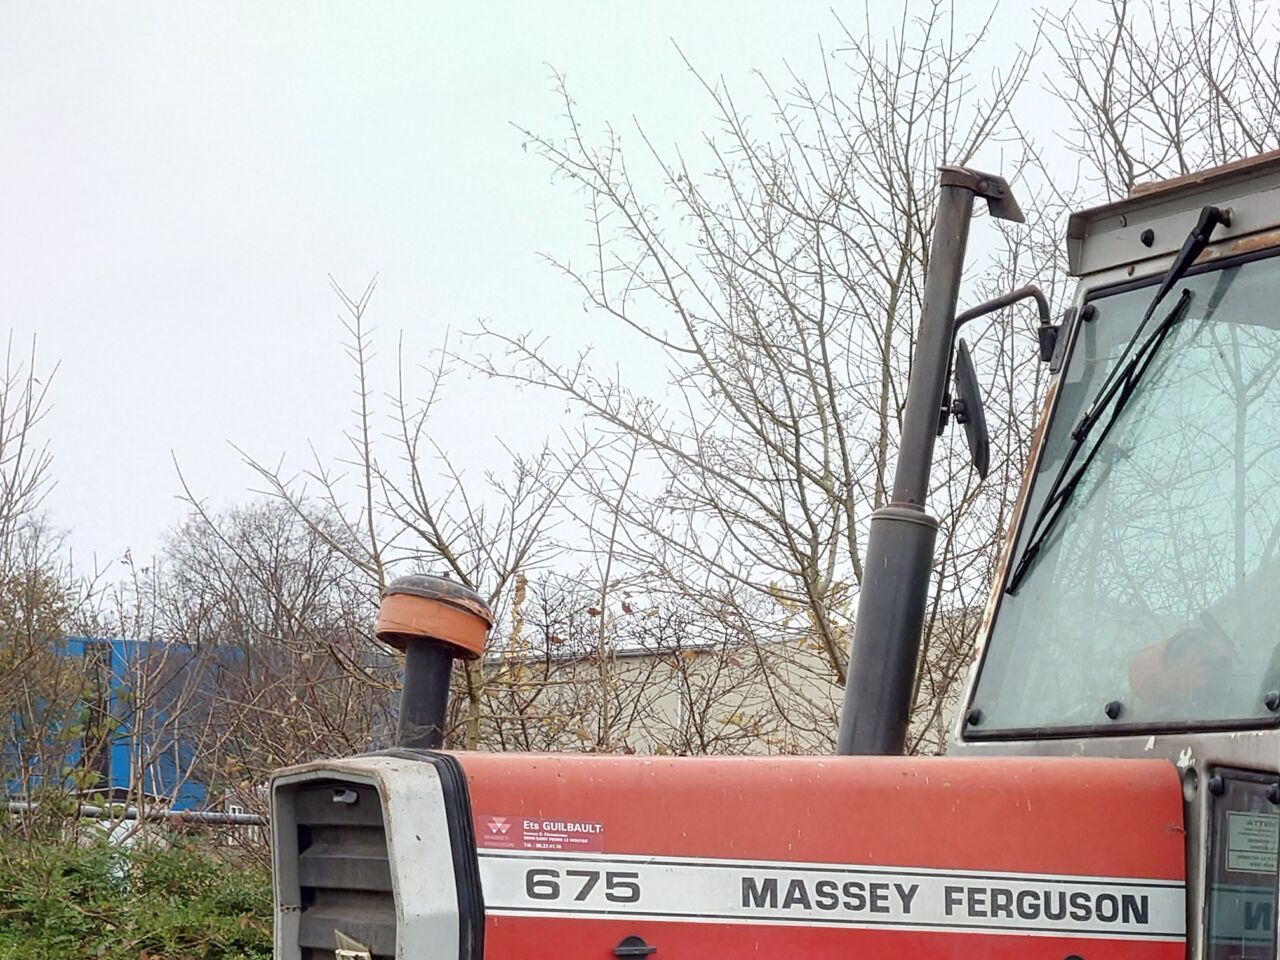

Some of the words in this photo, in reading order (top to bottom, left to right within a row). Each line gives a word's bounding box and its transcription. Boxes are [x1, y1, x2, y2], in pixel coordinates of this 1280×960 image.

[523, 820, 540, 830] Ets
[543, 821, 602, 833] GUILBAULT
[526, 869, 641, 903] 675
[742, 877, 919, 914] MASSEY
[944, 886, 1149, 925] FERGUSON
